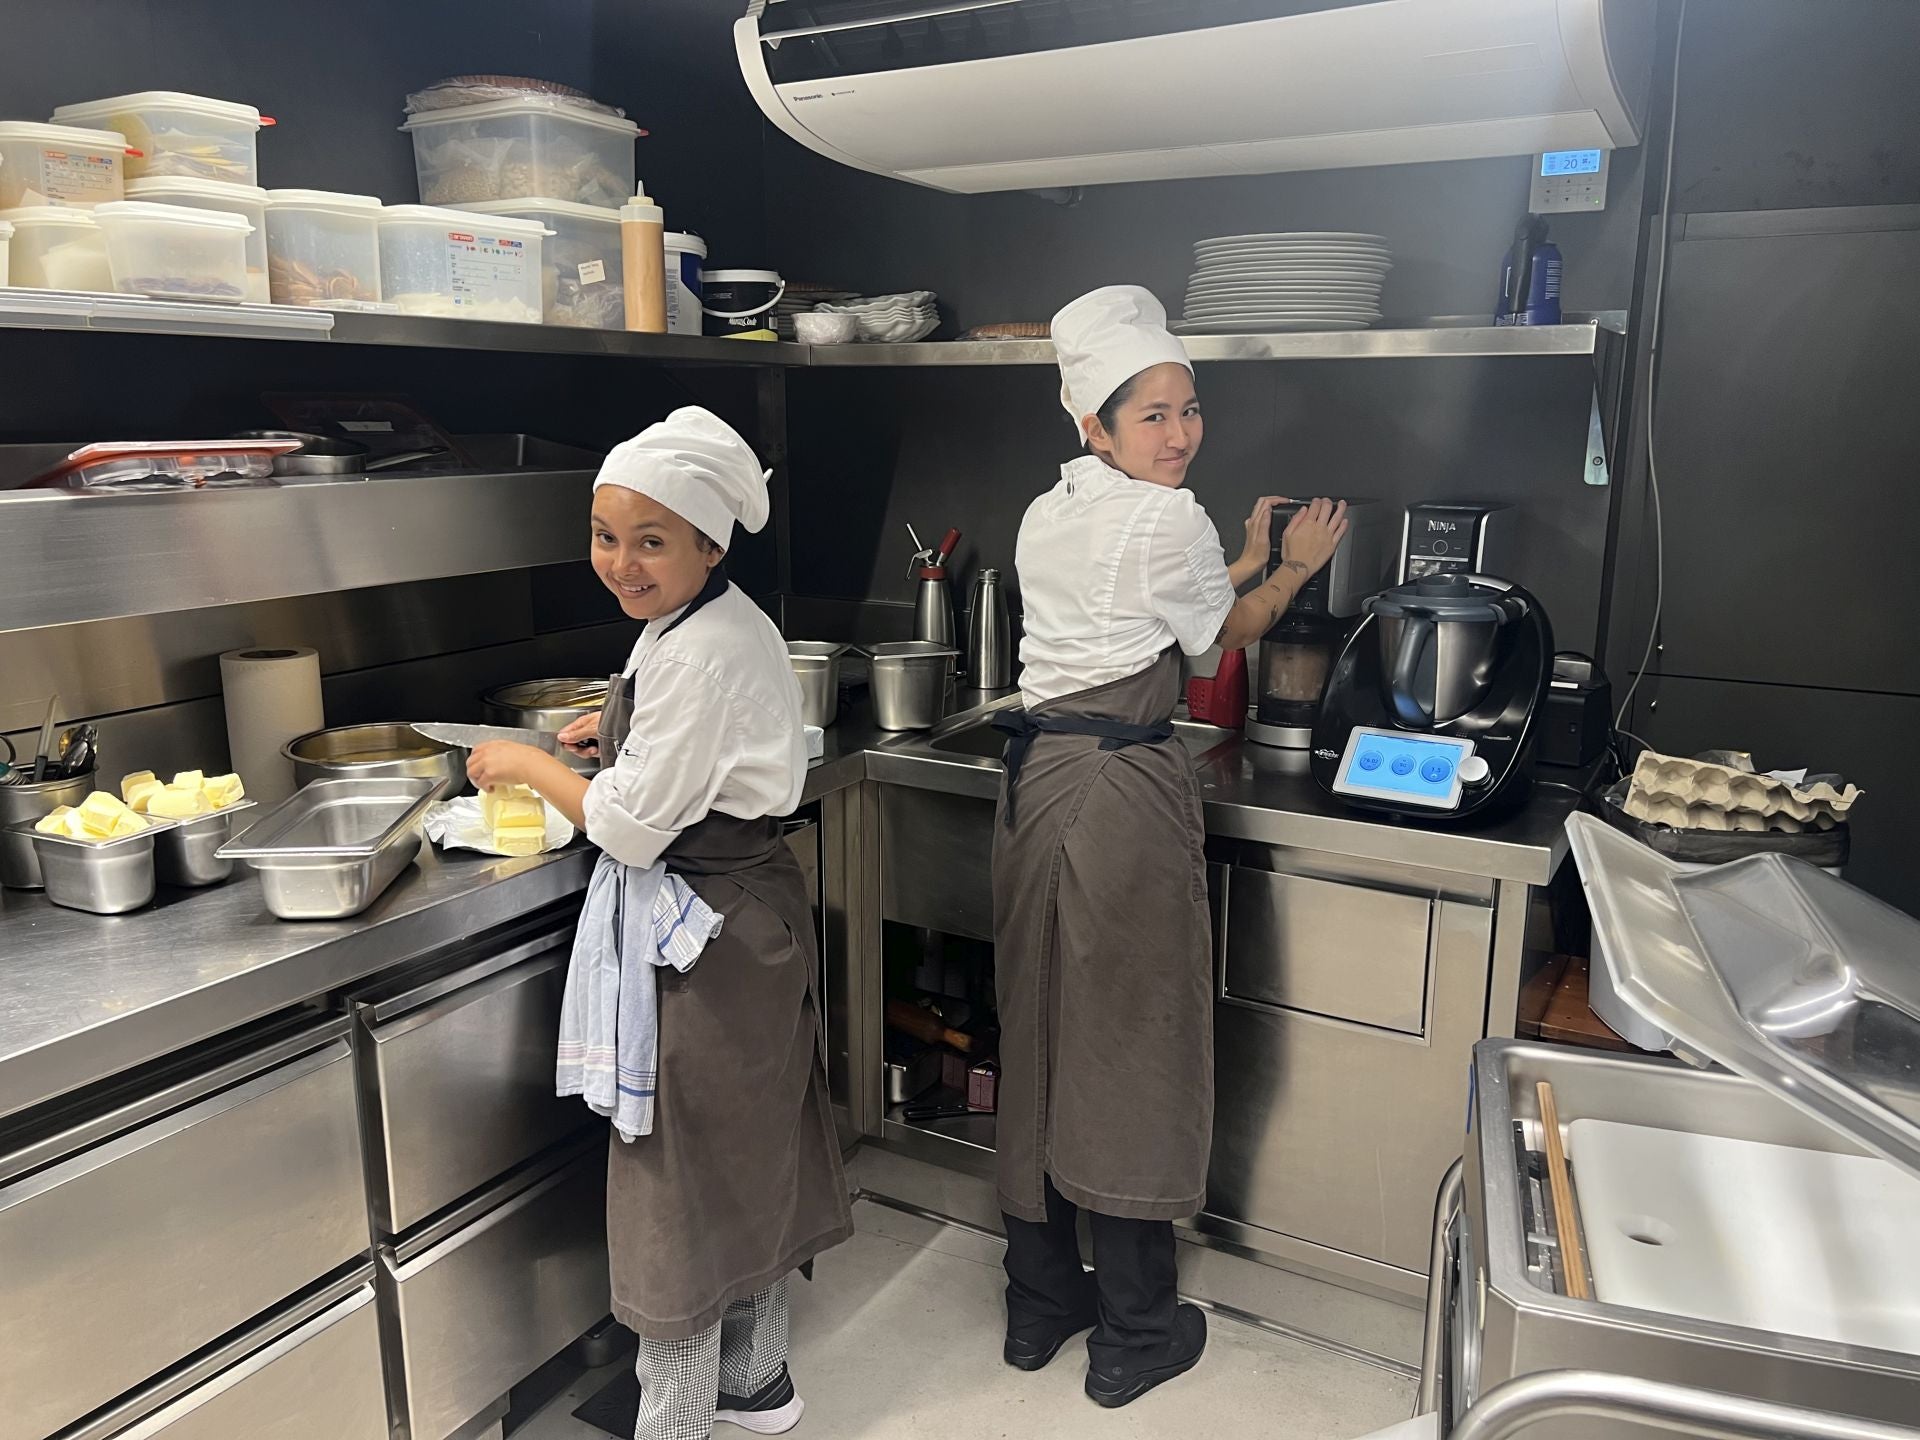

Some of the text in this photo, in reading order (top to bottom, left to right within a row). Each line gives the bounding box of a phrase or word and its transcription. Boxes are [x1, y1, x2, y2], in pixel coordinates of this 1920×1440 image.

[793, 94, 823, 102] Panasonic
[1563, 158, 1578, 170] 20
[1428, 519, 1456, 533] NINJA
